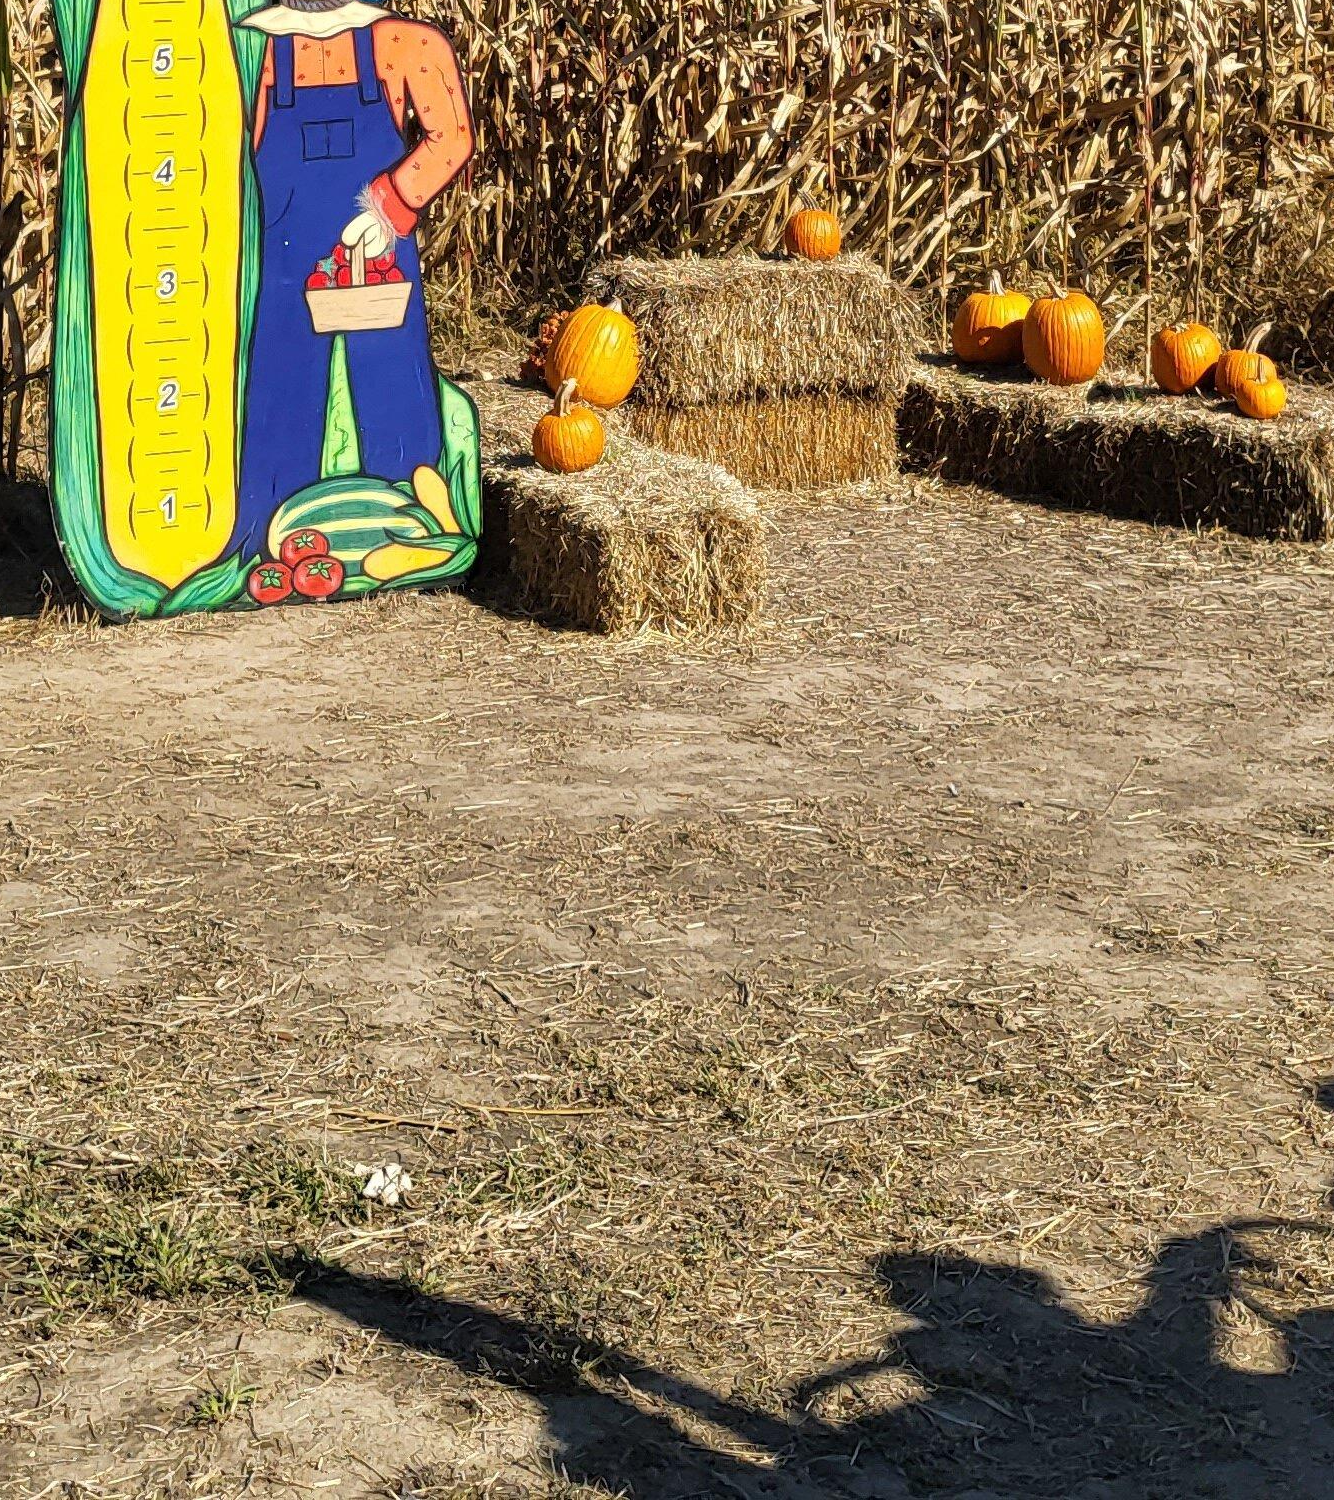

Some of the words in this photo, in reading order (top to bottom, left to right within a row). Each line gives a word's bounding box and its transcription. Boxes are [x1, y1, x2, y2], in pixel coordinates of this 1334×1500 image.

[155, 47, 171, 72] 5
[156, 159, 173, 183] 4
[159, 271, 175, 296] 3
[160, 383, 177, 408] 2
[162, 497, 173, 520] 1
